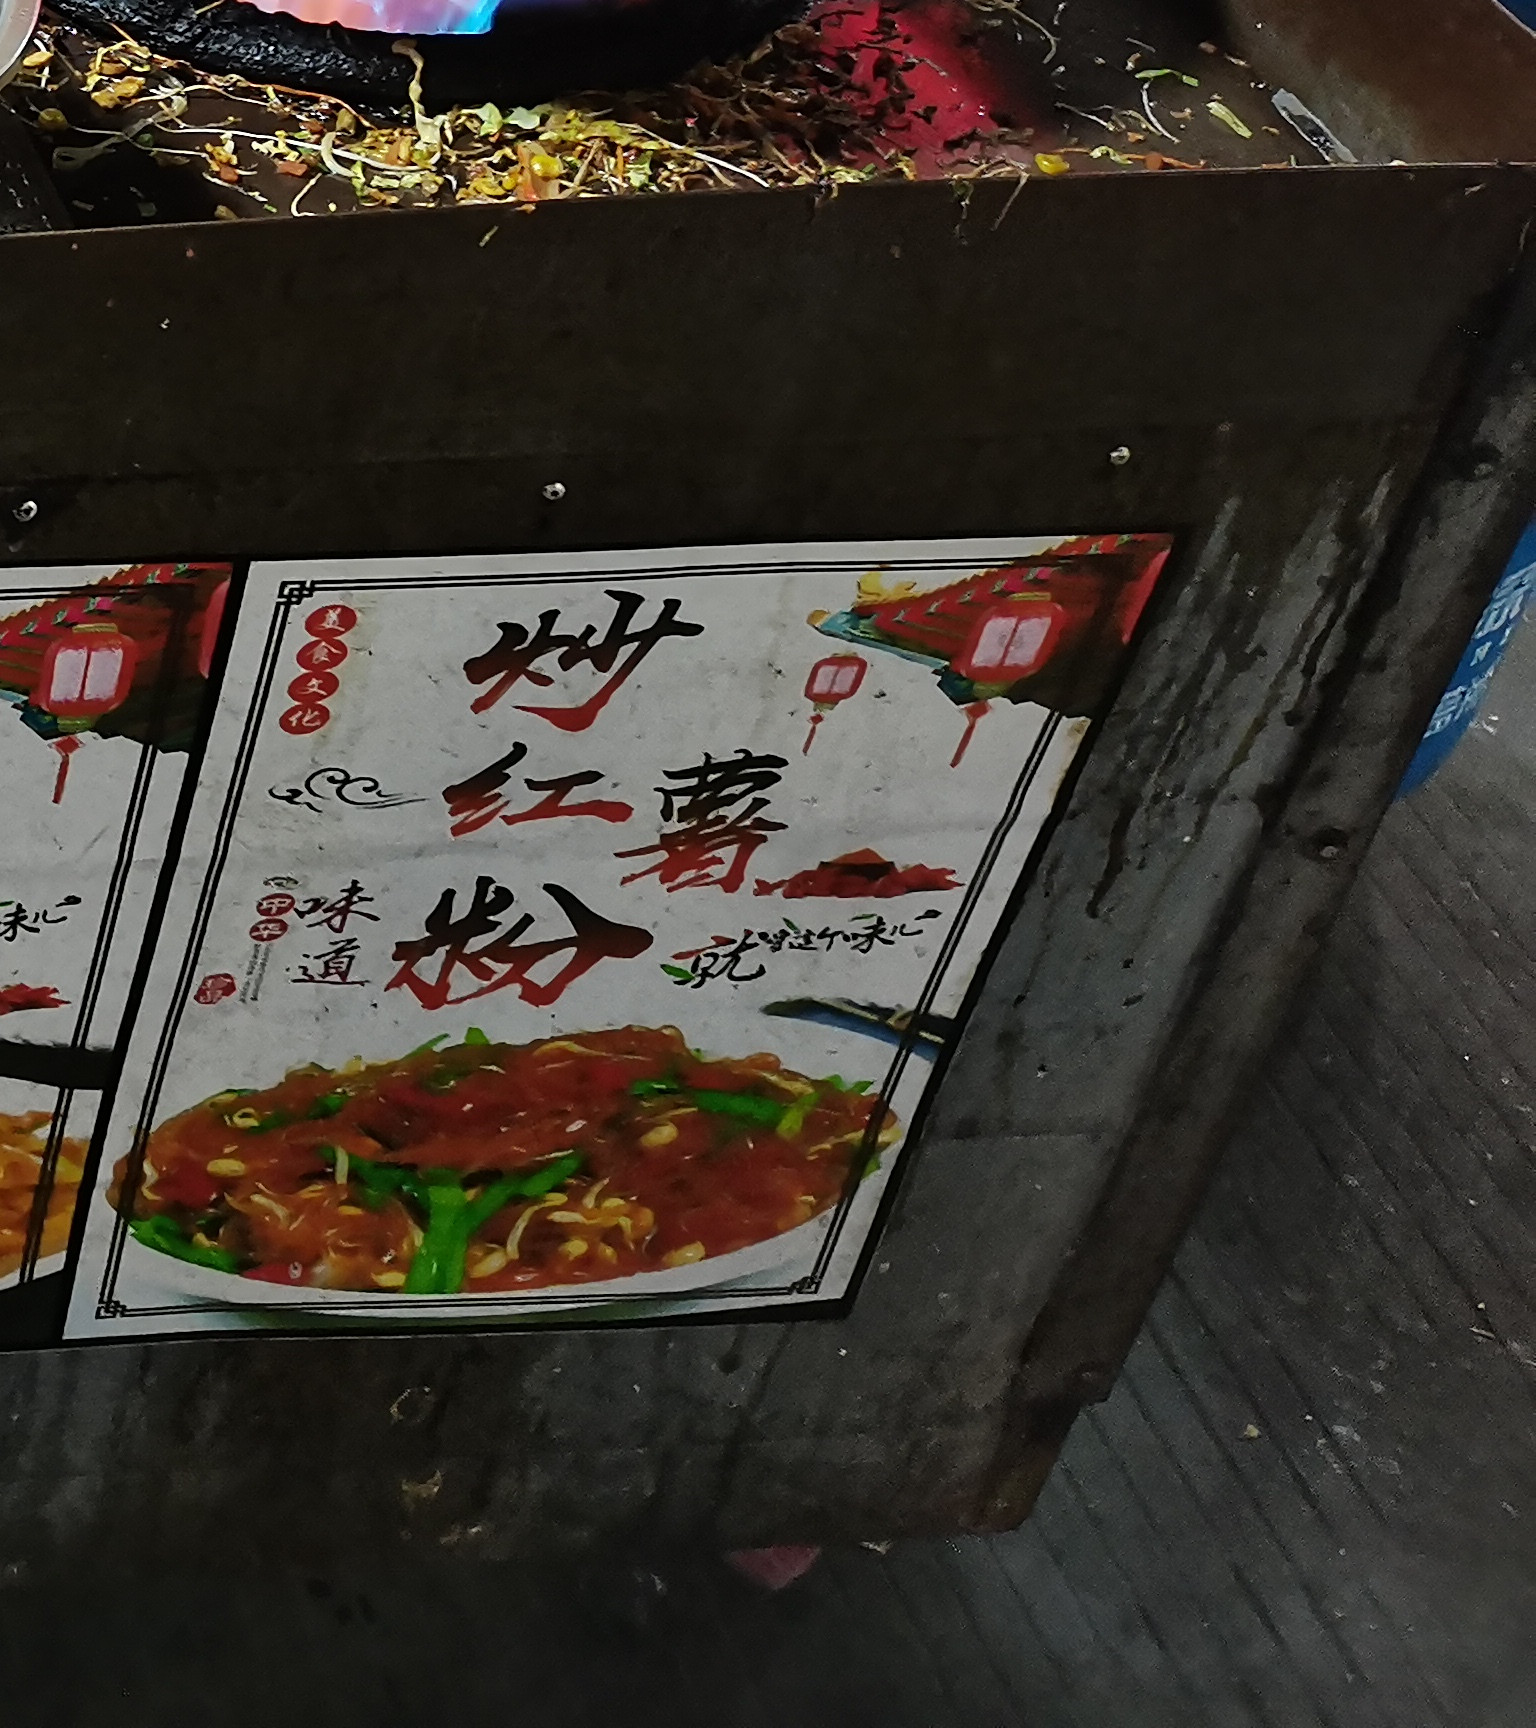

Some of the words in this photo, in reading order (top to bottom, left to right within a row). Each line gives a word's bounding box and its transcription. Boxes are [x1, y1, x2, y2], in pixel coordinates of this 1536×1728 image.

[282, 605, 351, 730] 美食文化
[464, 590, 705, 732] 炒
